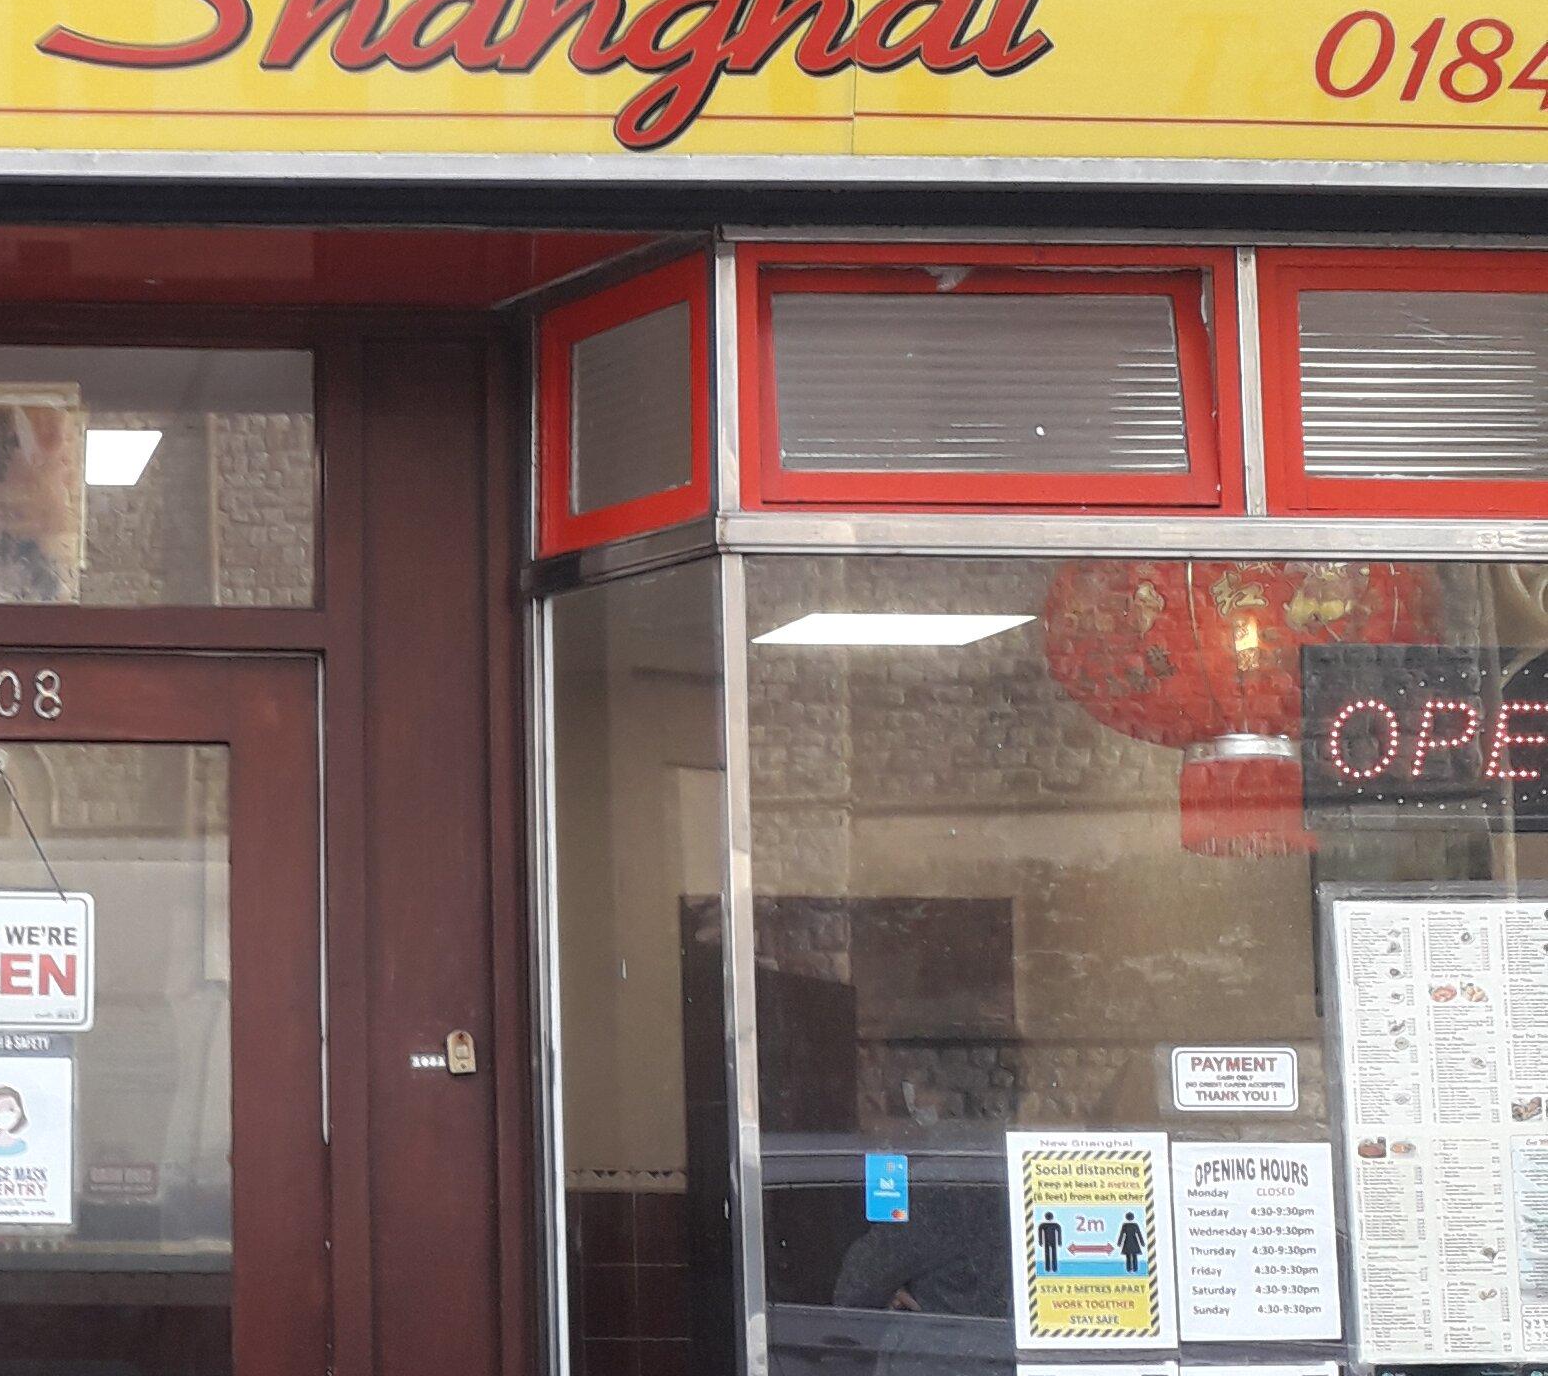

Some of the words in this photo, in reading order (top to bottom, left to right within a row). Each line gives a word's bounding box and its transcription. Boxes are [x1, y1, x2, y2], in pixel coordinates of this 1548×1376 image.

[5, 926, 78, 946] WE'RE
[1190, 1056, 1278, 1072] PAYMENT
[1195, 1091, 1240, 1102] THANK
[1242, 1091, 1269, 1102] YOU
[1039, 1139, 1068, 1147] New
[1035, 1164, 1072, 1175] Social
[1075, 1164, 1140, 1177] distancing
[1195, 1158, 1256, 1187] OPENING
[1260, 1158, 1309, 1187] HOURS
[1187, 1189, 1229, 1199] Monday
[1256, 1188, 1295, 1197] CLOSED
[1187, 1208, 1229, 1218] Tuesday
[1075, 1215, 1105, 1232] 2m
[1189, 1227, 1247, 1238] Wednesday
[1190, 1246, 1236, 1257] Thursday
[1191, 1266, 1222, 1277] Friday
[1192, 1285, 1236, 1295] Saturday
[1193, 1305, 1230, 1316] Sunday
[1069, 1315, 1093, 1324] STAY
